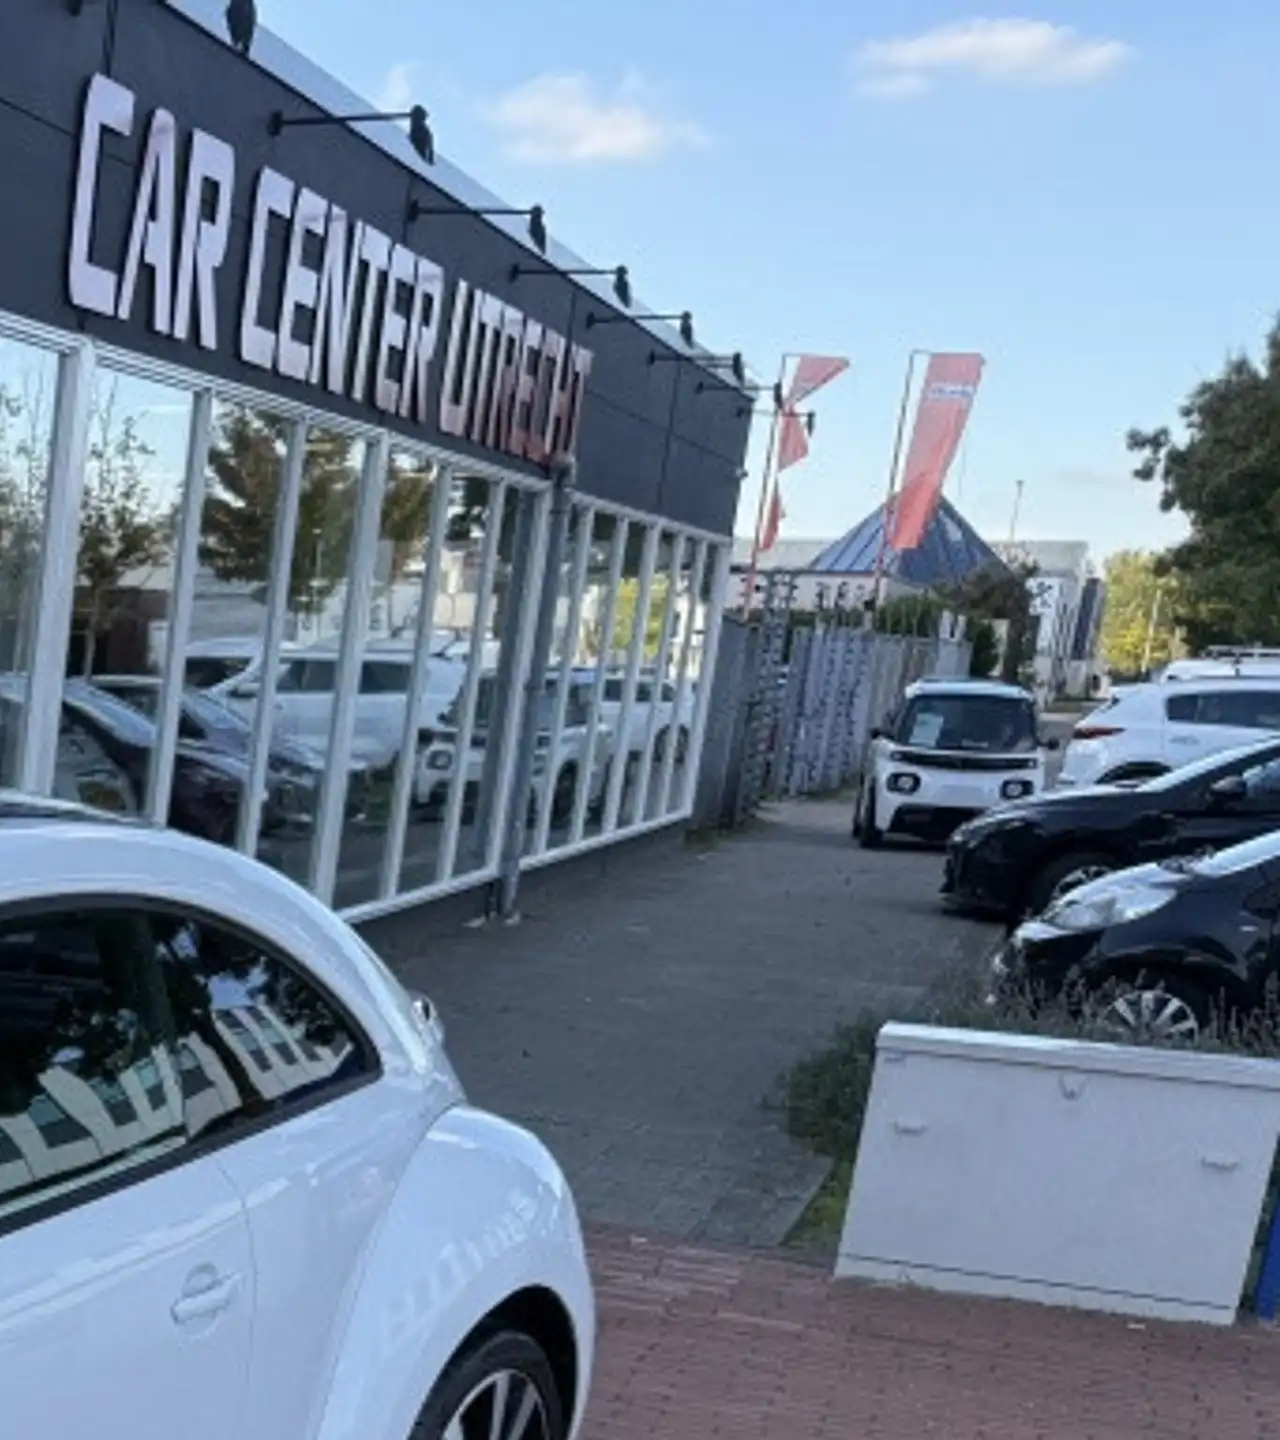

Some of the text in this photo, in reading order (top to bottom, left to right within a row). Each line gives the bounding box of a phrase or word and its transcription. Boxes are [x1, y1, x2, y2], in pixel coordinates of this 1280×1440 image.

[68, 72, 595, 470] CAR CENTER UTRECHT
